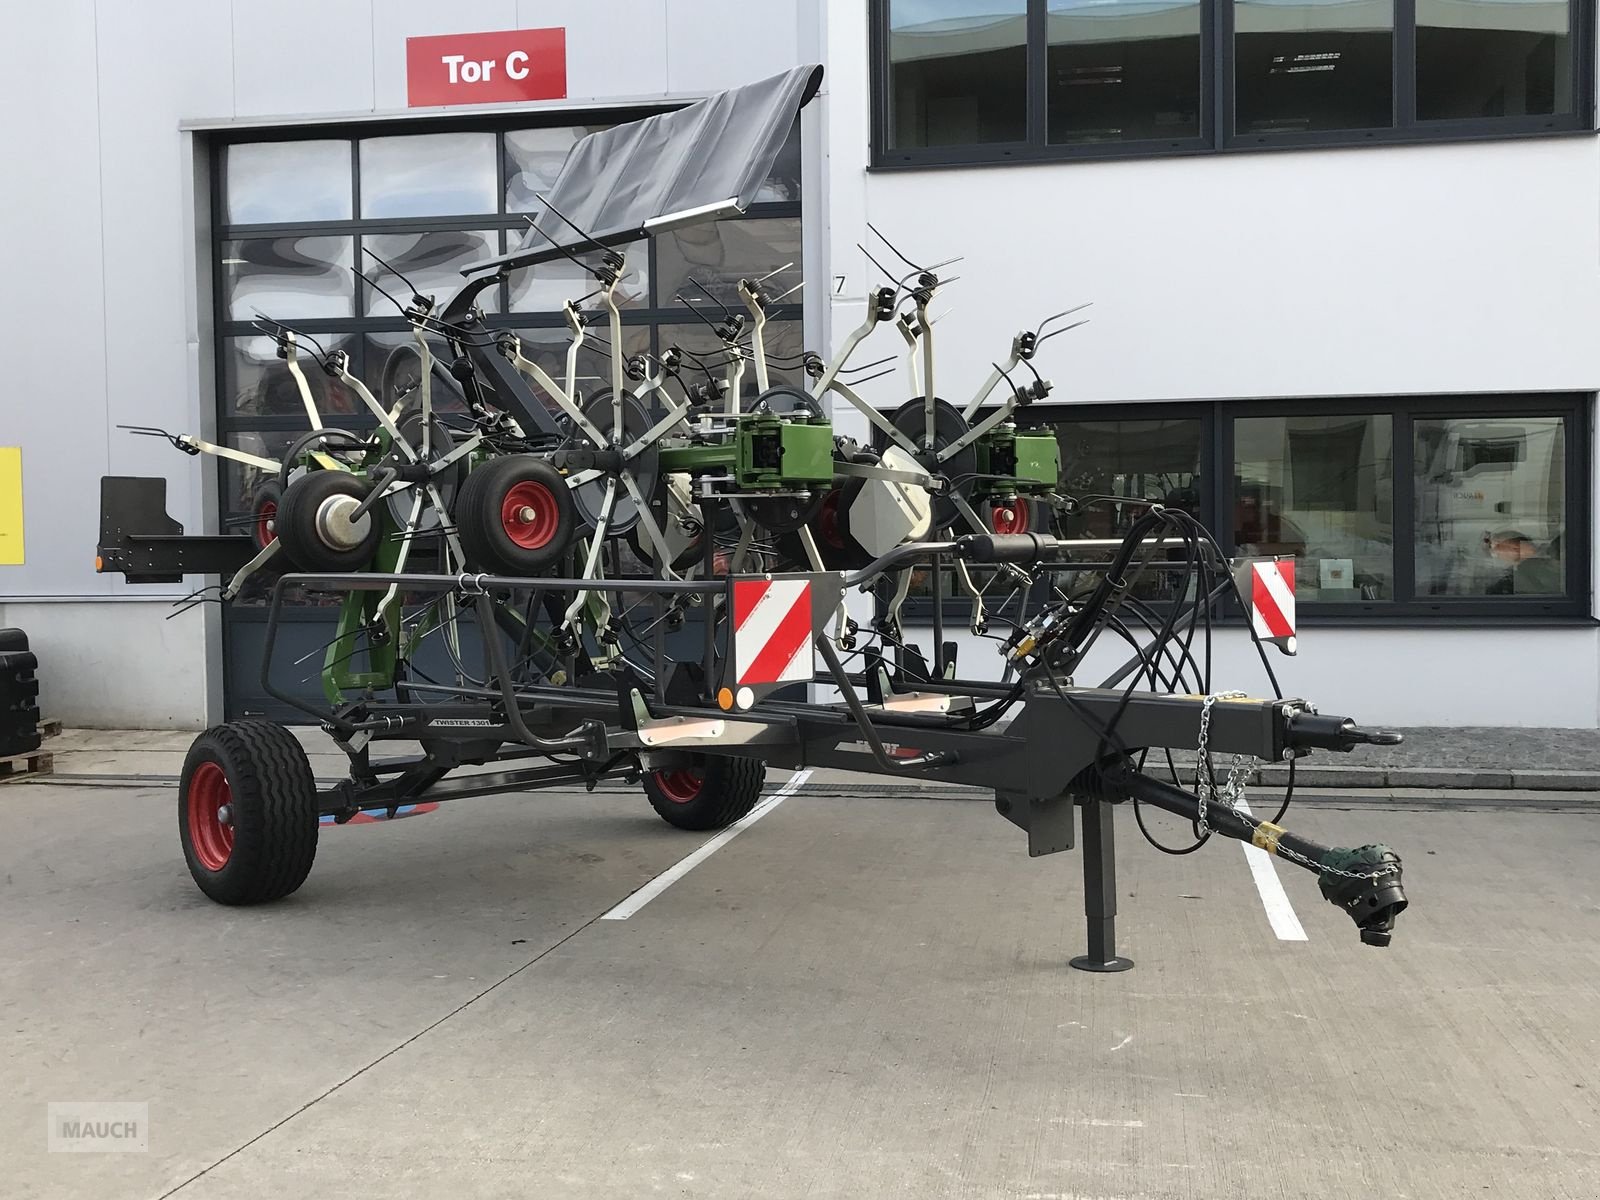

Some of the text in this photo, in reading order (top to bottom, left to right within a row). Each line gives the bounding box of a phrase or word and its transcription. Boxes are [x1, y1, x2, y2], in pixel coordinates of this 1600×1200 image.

[442, 50, 530, 84] Tor C
[835, 275, 846, 294] 7
[435, 719, 470, 727] TWISTER
